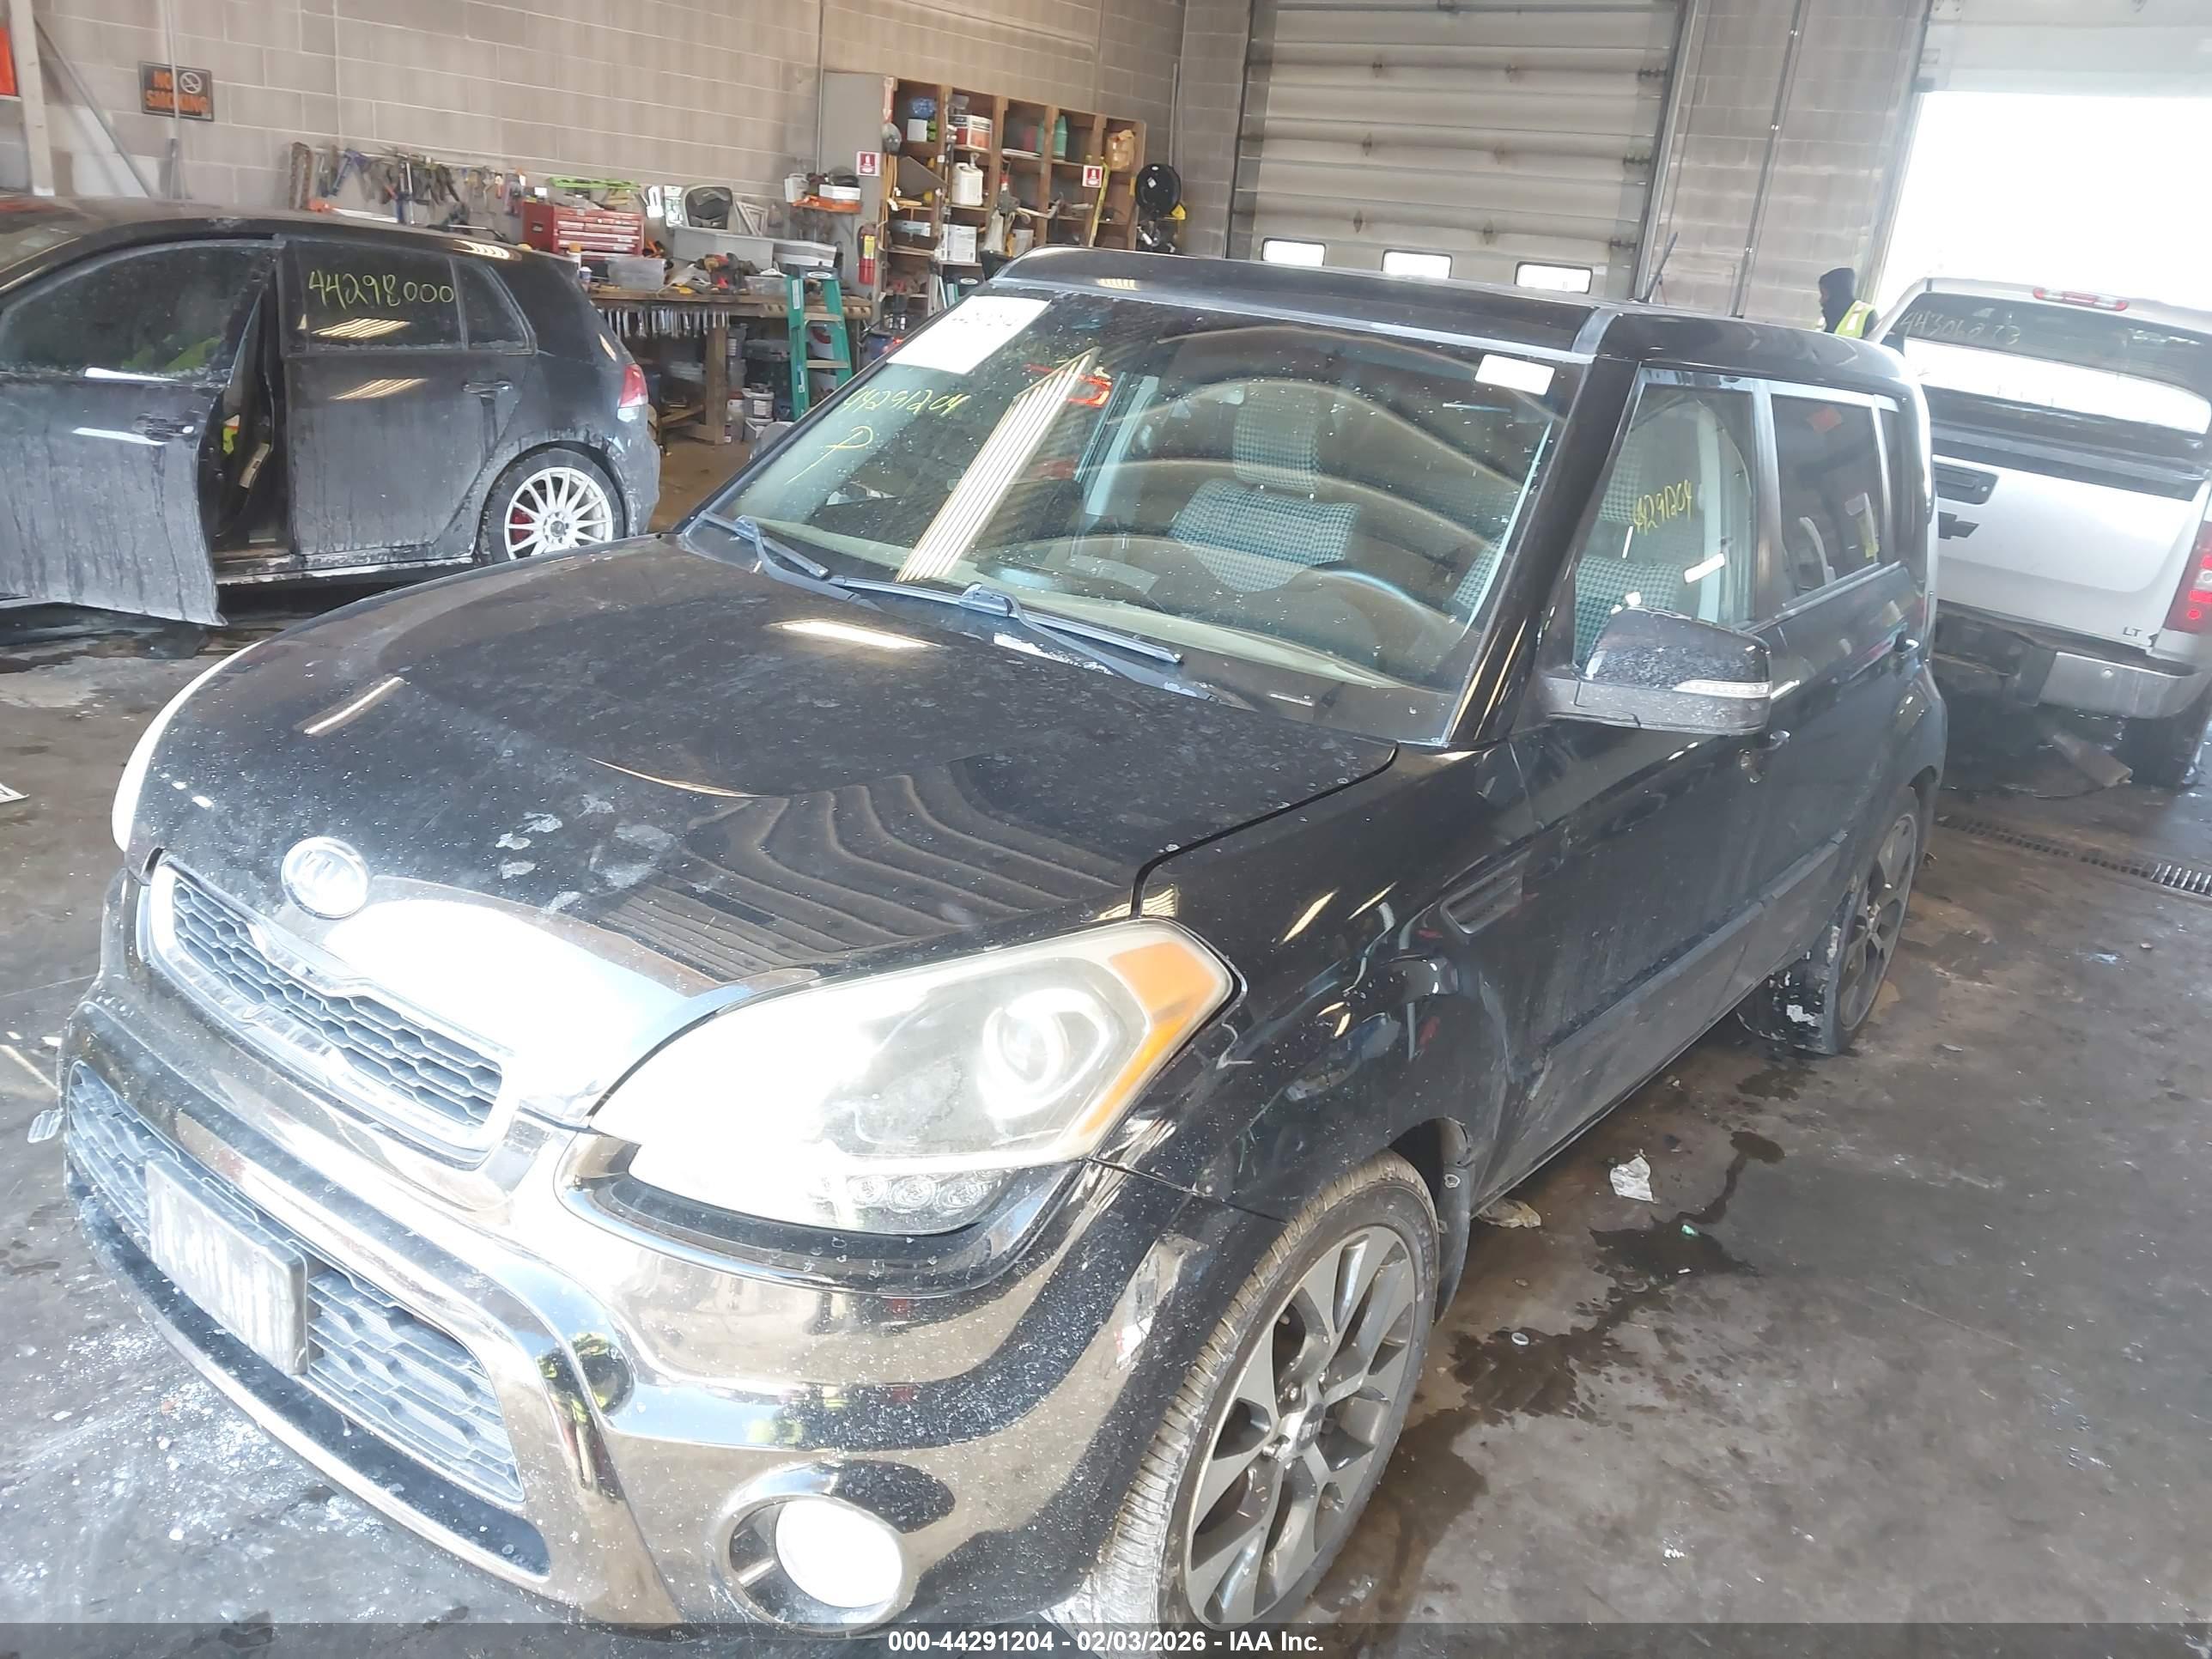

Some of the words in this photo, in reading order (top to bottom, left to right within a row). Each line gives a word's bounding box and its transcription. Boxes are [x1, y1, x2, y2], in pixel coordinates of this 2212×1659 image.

[151, 69, 173, 90] NO
[309, 269, 455, 310] 44298000
[2123, 627, 2142, 637] LT
